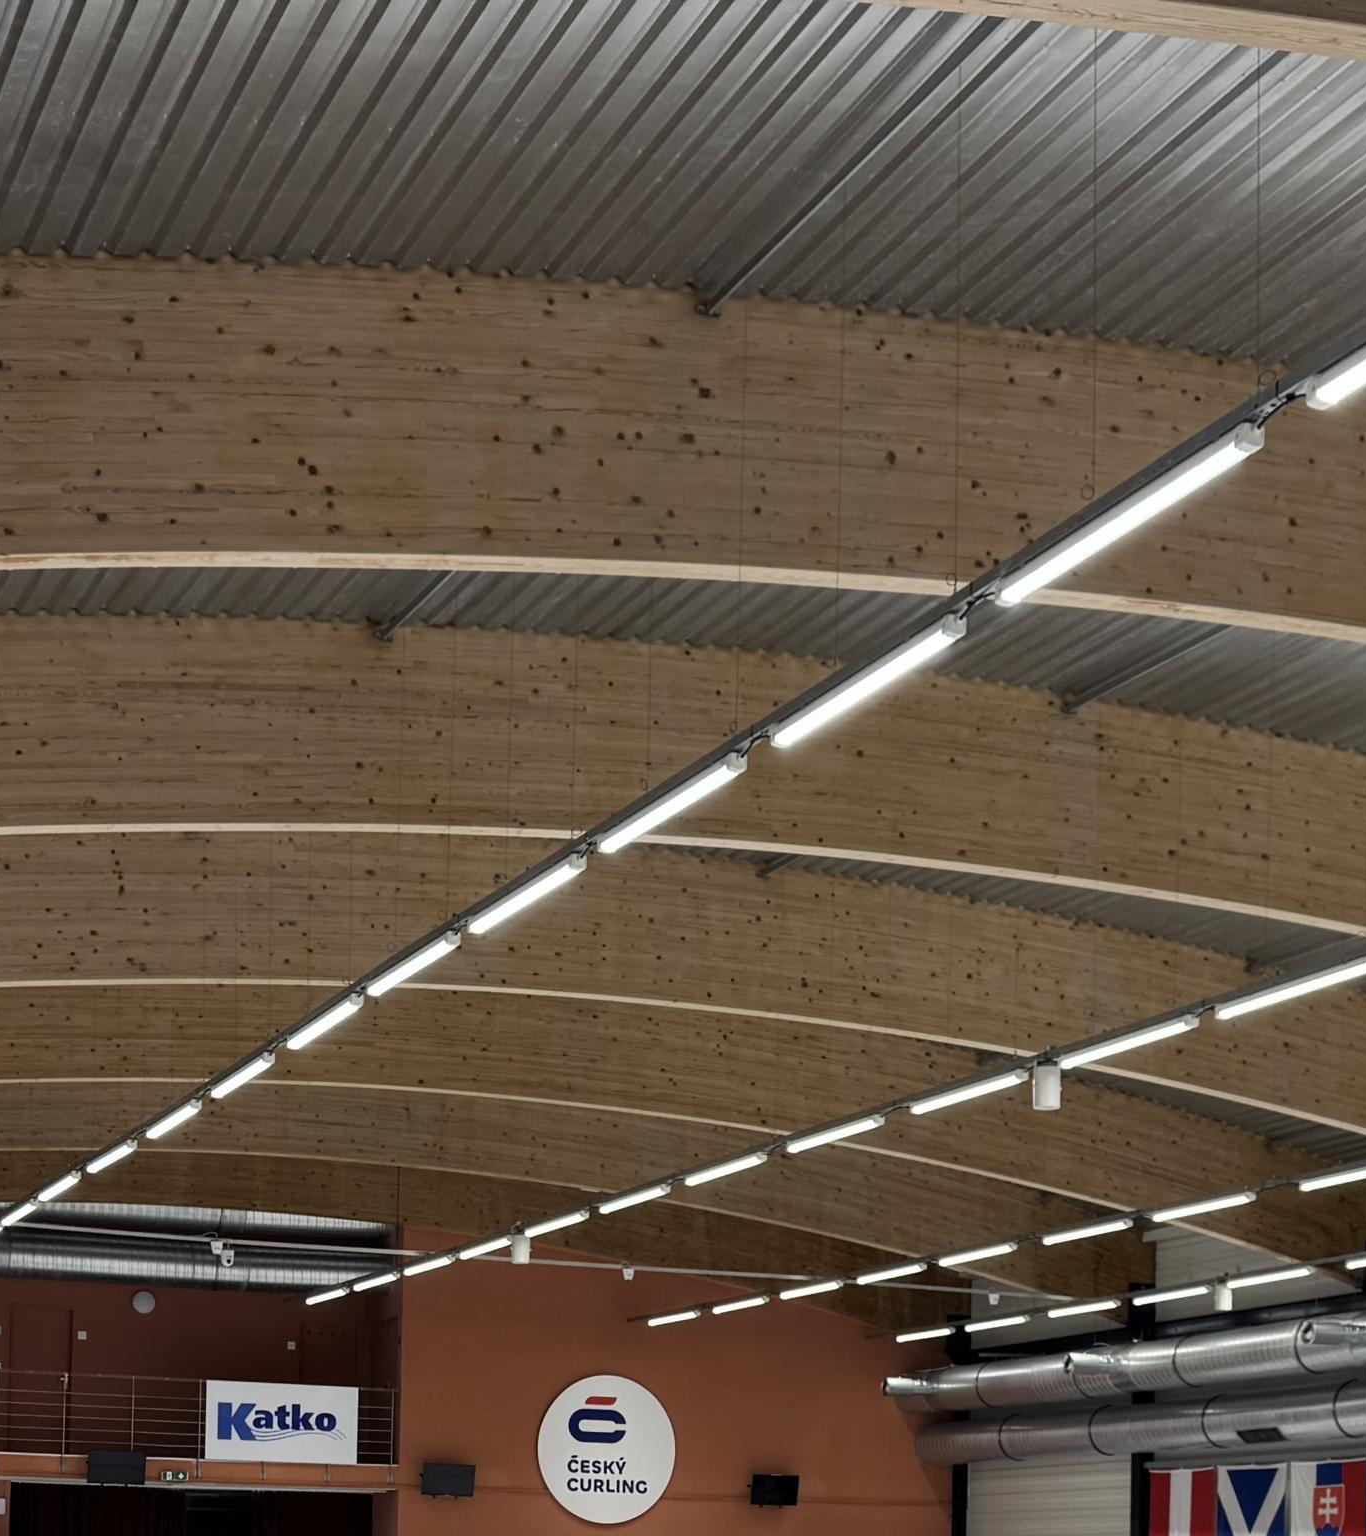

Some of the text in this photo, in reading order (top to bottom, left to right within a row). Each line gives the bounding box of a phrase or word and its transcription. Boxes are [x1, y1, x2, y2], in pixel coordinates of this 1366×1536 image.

[217, 1402, 337, 1441] Katko
[567, 1455, 626, 1475] ČESKÝ
[567, 1478, 648, 1494] CURLING
